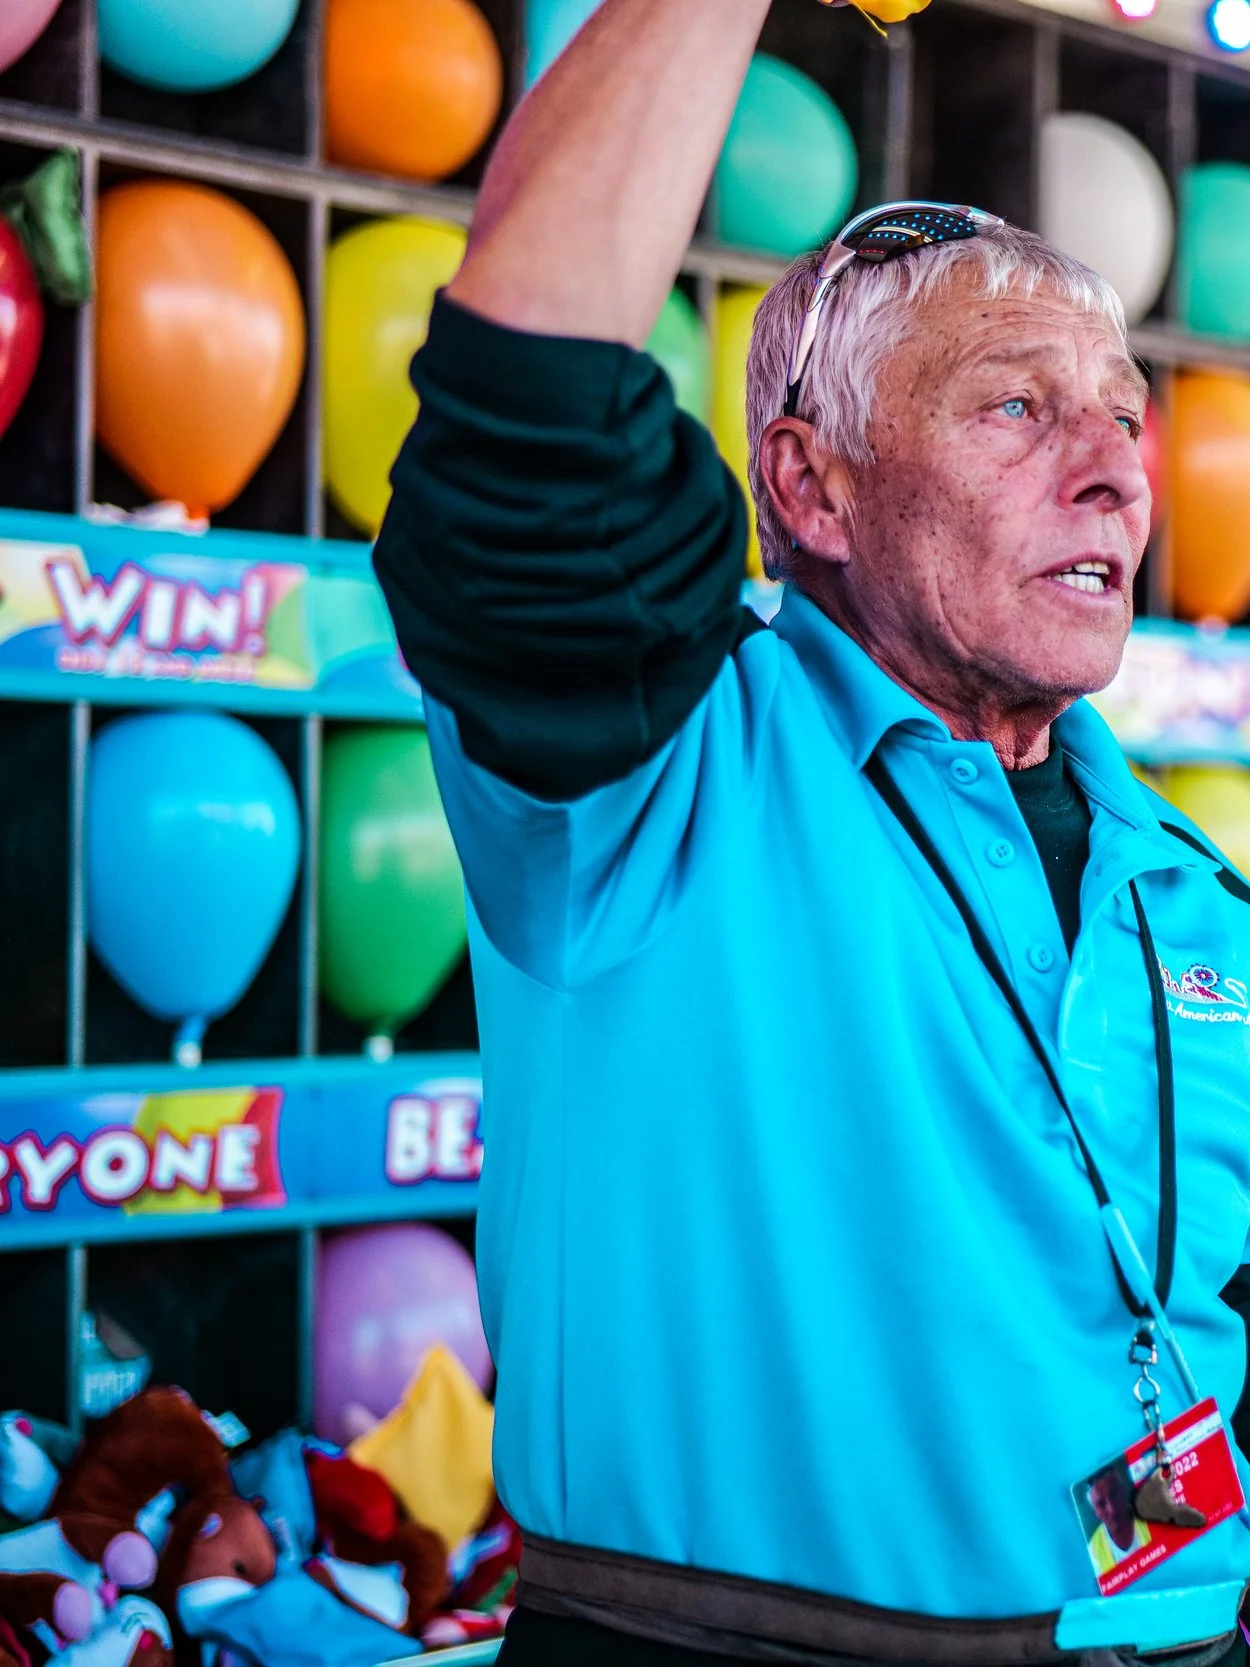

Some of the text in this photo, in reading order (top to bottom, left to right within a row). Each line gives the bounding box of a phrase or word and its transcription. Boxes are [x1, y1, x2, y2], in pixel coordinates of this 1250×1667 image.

[46, 557, 268, 655] WIN!
[1175, 1002, 1243, 1022] American
[388, 1096, 483, 1184] BE
[1171, 1451, 1199, 1479] 022
[1102, 1544, 1167, 1593] FAIRPLAY GAMES
